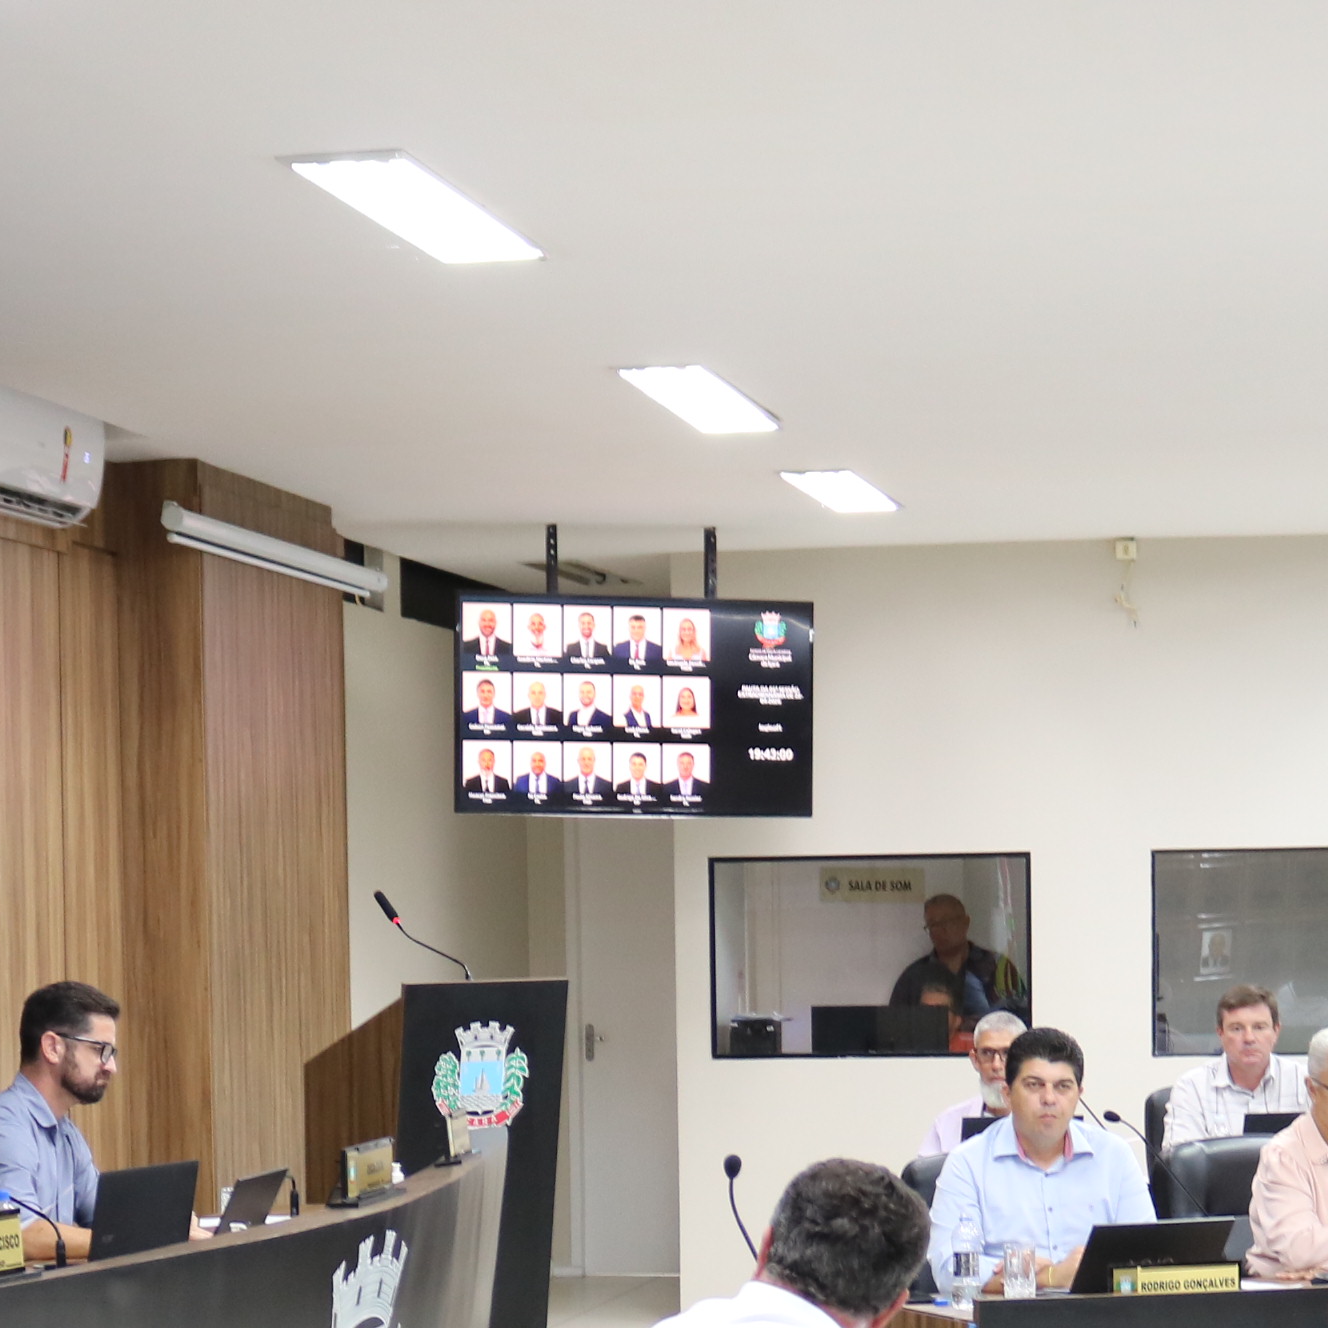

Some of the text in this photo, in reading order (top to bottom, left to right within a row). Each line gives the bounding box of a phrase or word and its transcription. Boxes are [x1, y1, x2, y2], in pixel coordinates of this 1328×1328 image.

[848, 880, 912, 891] SALA DE SOM
[1141, 1277, 1236, 1293] RODRIGO GONÇALVES
